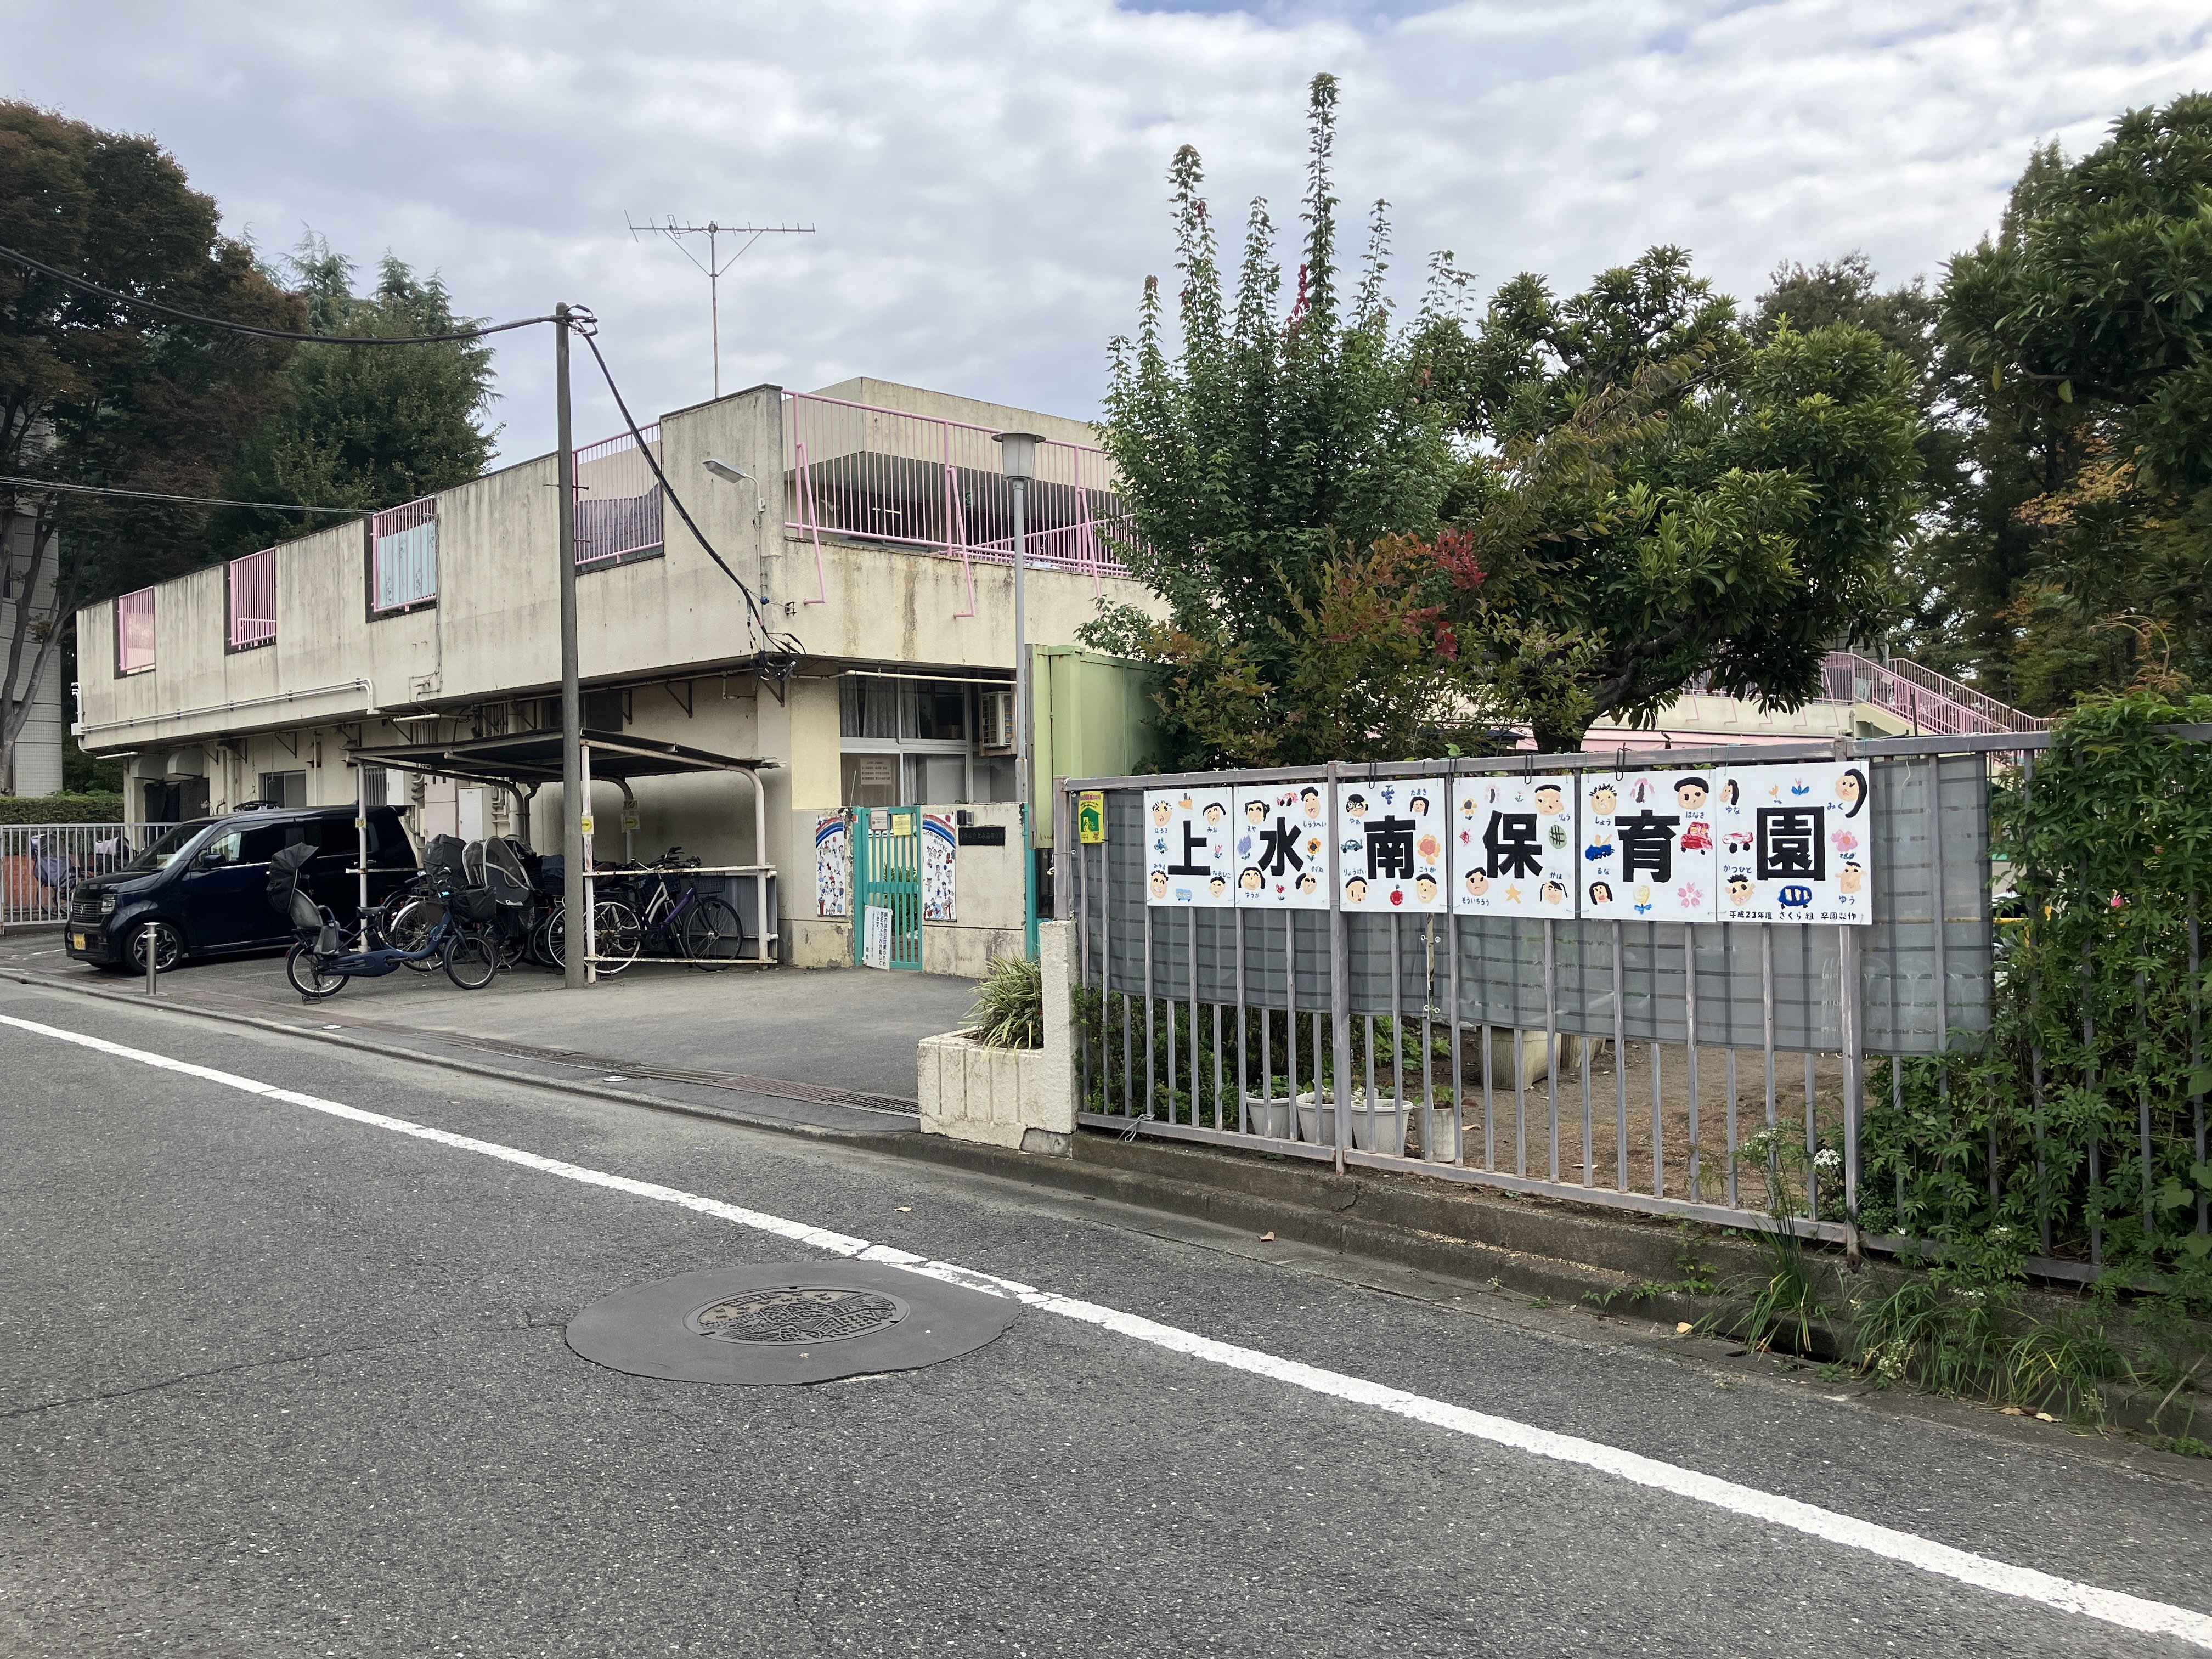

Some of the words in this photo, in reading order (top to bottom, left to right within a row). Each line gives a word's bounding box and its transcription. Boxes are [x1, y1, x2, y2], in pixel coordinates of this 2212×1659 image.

[1725, 806, 1740, 815] ゆな
[1827, 802, 1843, 810] みく
[1595, 816, 1611, 826] しょう
[1168, 806, 1826, 883] 上水南保育園
[1344, 868, 1366, 876] りょうけい
[1723, 865, 1752, 874] かつひと
[1212, 870, 1231, 879] なおひこ
[1462, 896, 1489, 906] そういちろう
[1839, 895, 1855, 905] ゆう
[1729, 910, 1773, 919] 平成23年度
[1779, 911, 1814, 921] さくら組
